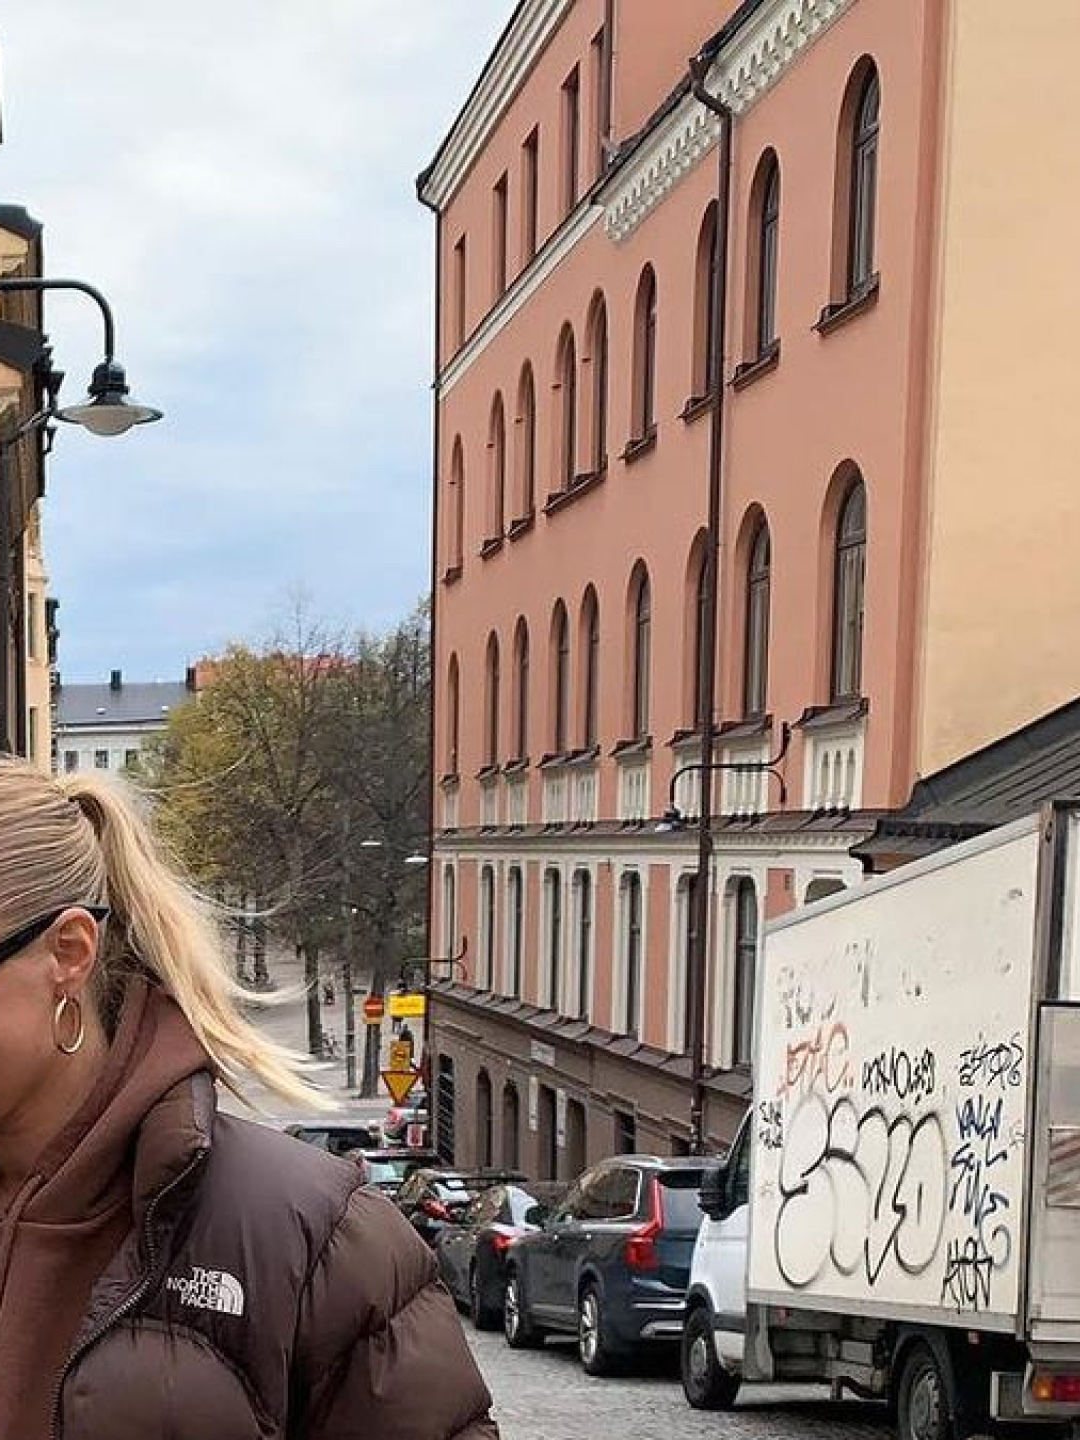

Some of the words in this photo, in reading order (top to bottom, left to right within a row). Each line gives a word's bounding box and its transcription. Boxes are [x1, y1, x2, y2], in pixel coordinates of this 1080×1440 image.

[192, 1266, 221, 1285] THE
[166, 1277, 221, 1298] NORTH
[180, 1292, 219, 1310] FACE
